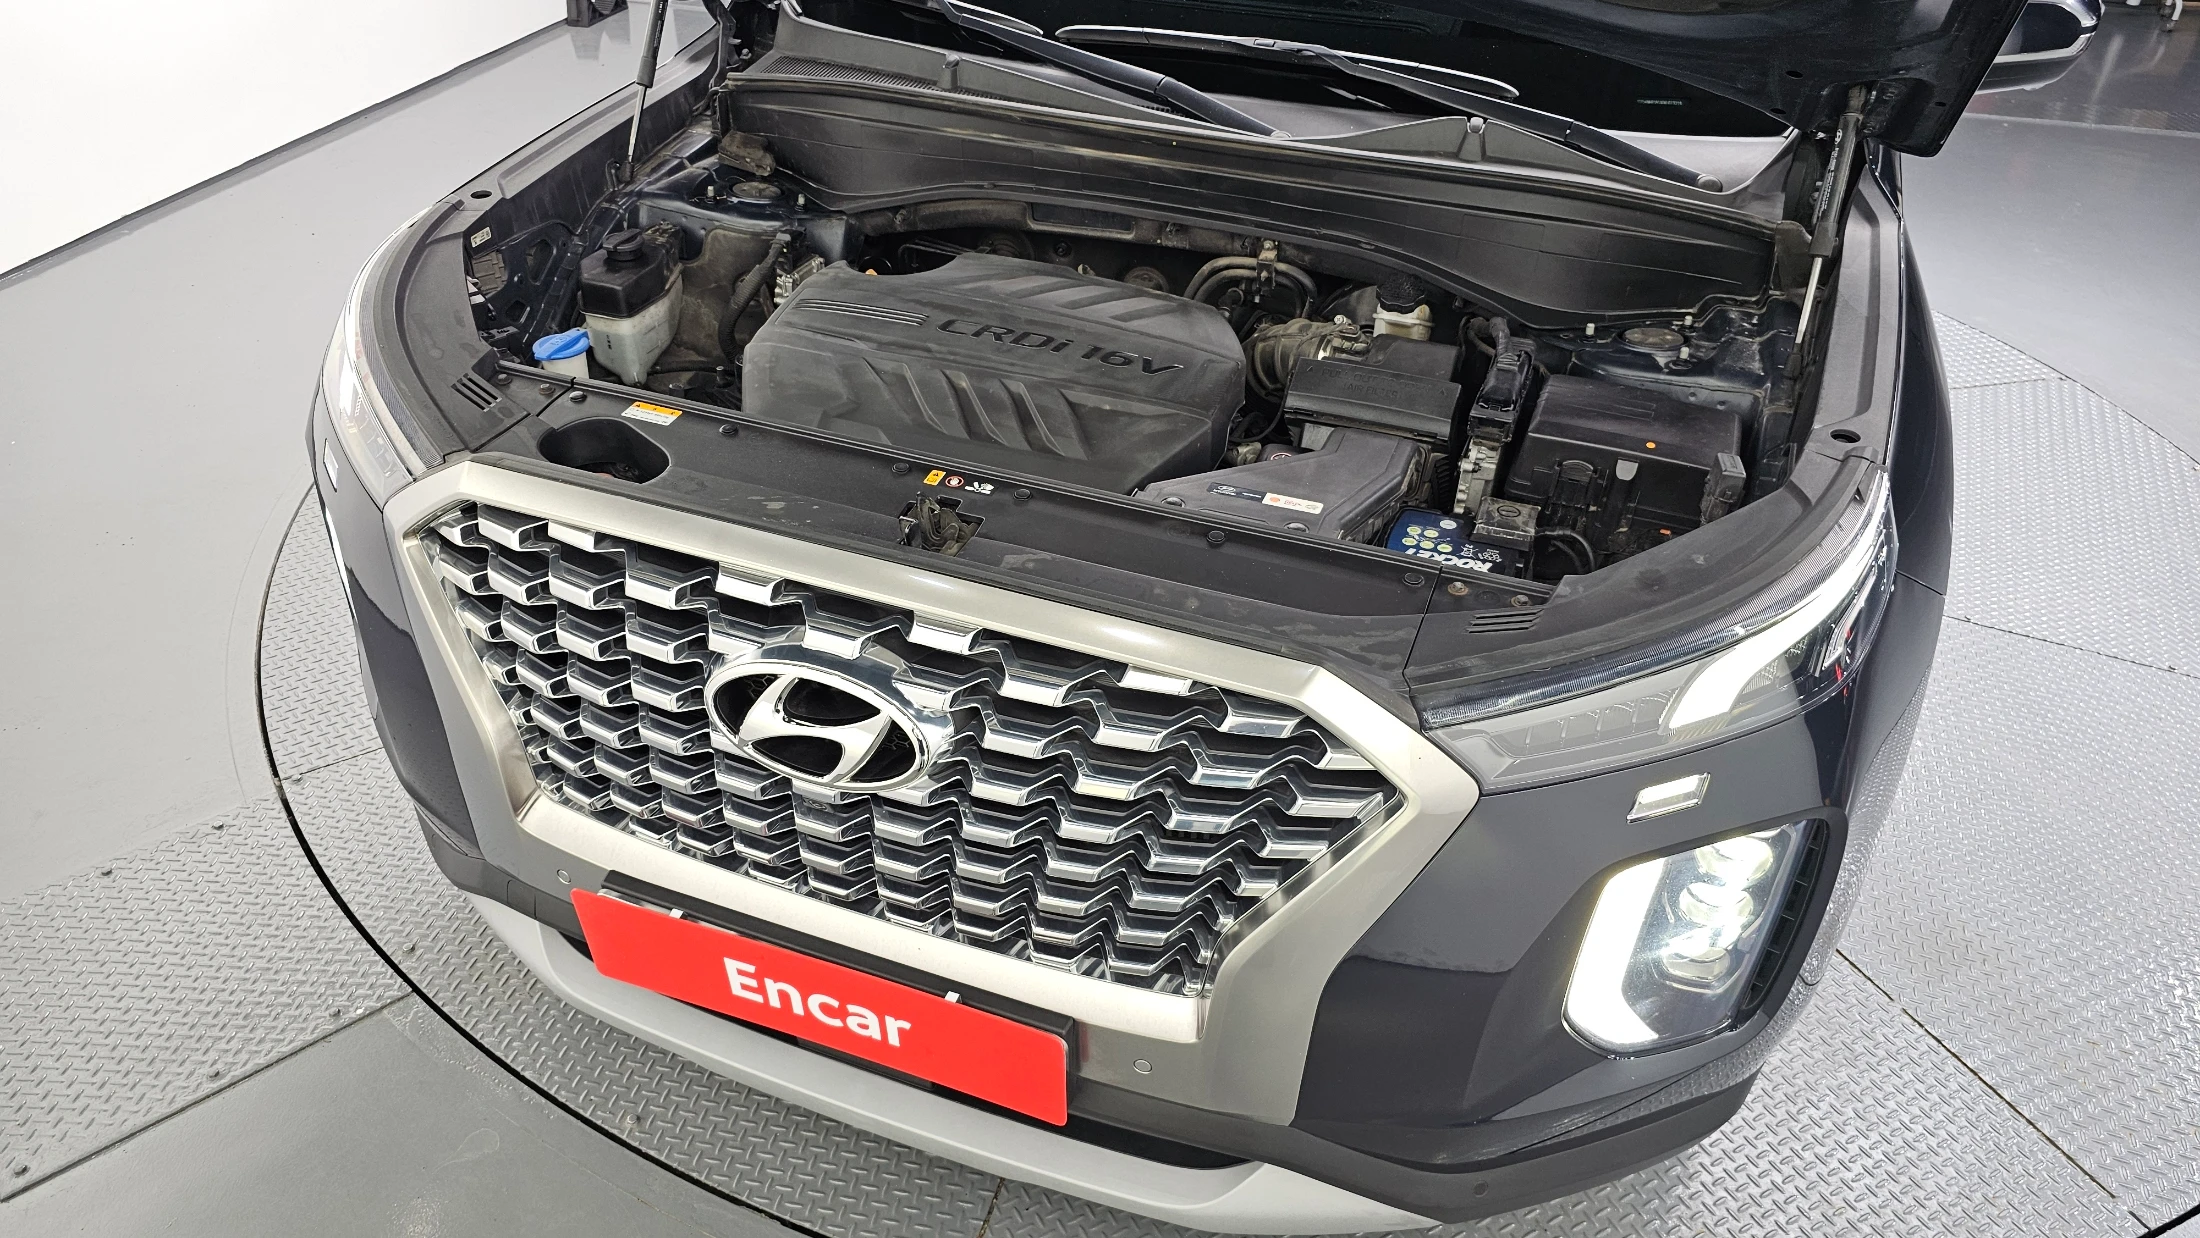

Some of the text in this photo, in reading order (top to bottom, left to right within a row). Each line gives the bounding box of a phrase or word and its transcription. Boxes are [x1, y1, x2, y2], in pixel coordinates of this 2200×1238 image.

[937, 319, 1184, 375] CRDi 16V
[723, 957, 911, 1047] Encar
